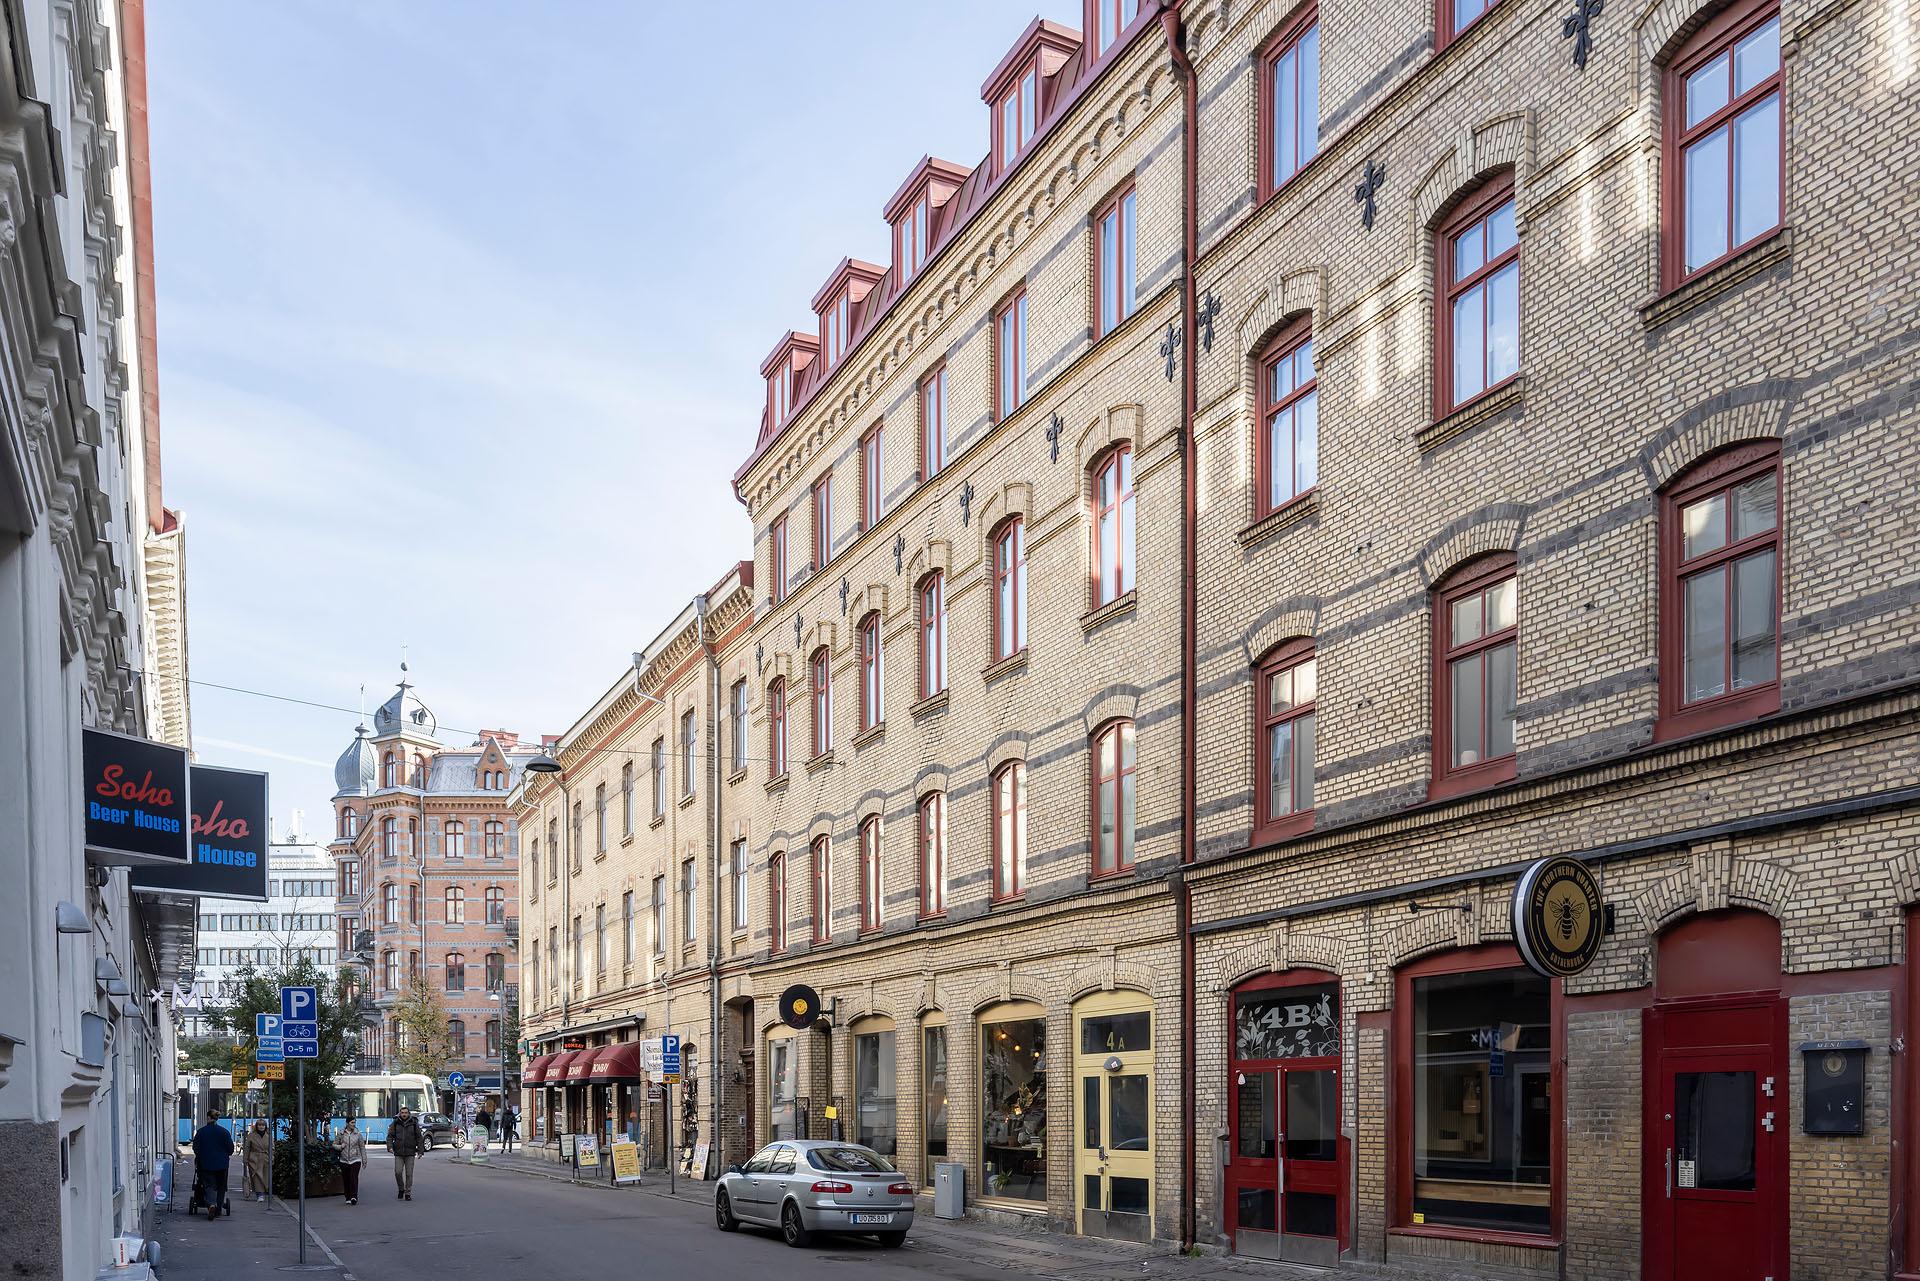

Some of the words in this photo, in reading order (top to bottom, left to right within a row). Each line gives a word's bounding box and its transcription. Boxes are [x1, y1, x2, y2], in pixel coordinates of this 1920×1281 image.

[96, 764, 174, 806] Soho
[89, 801, 130, 825] Beer
[134, 809, 180, 833] House
[191, 800, 249, 839] oho
[198, 843, 257, 868] House
[1535, 890, 1546, 907] THE
[1541, 865, 1576, 889] NORTHERN
[1576, 871, 1598, 911] QUARTER
[1549, 952, 1585, 968] GOTHENBURG
[290, 990, 310, 1018] P
[1260, 1004, 1311, 1029] 4B
[264, 1016, 279, 1035] P
[287, 1045, 304, 1053] 0-5
[666, 1036, 677, 1053] P
